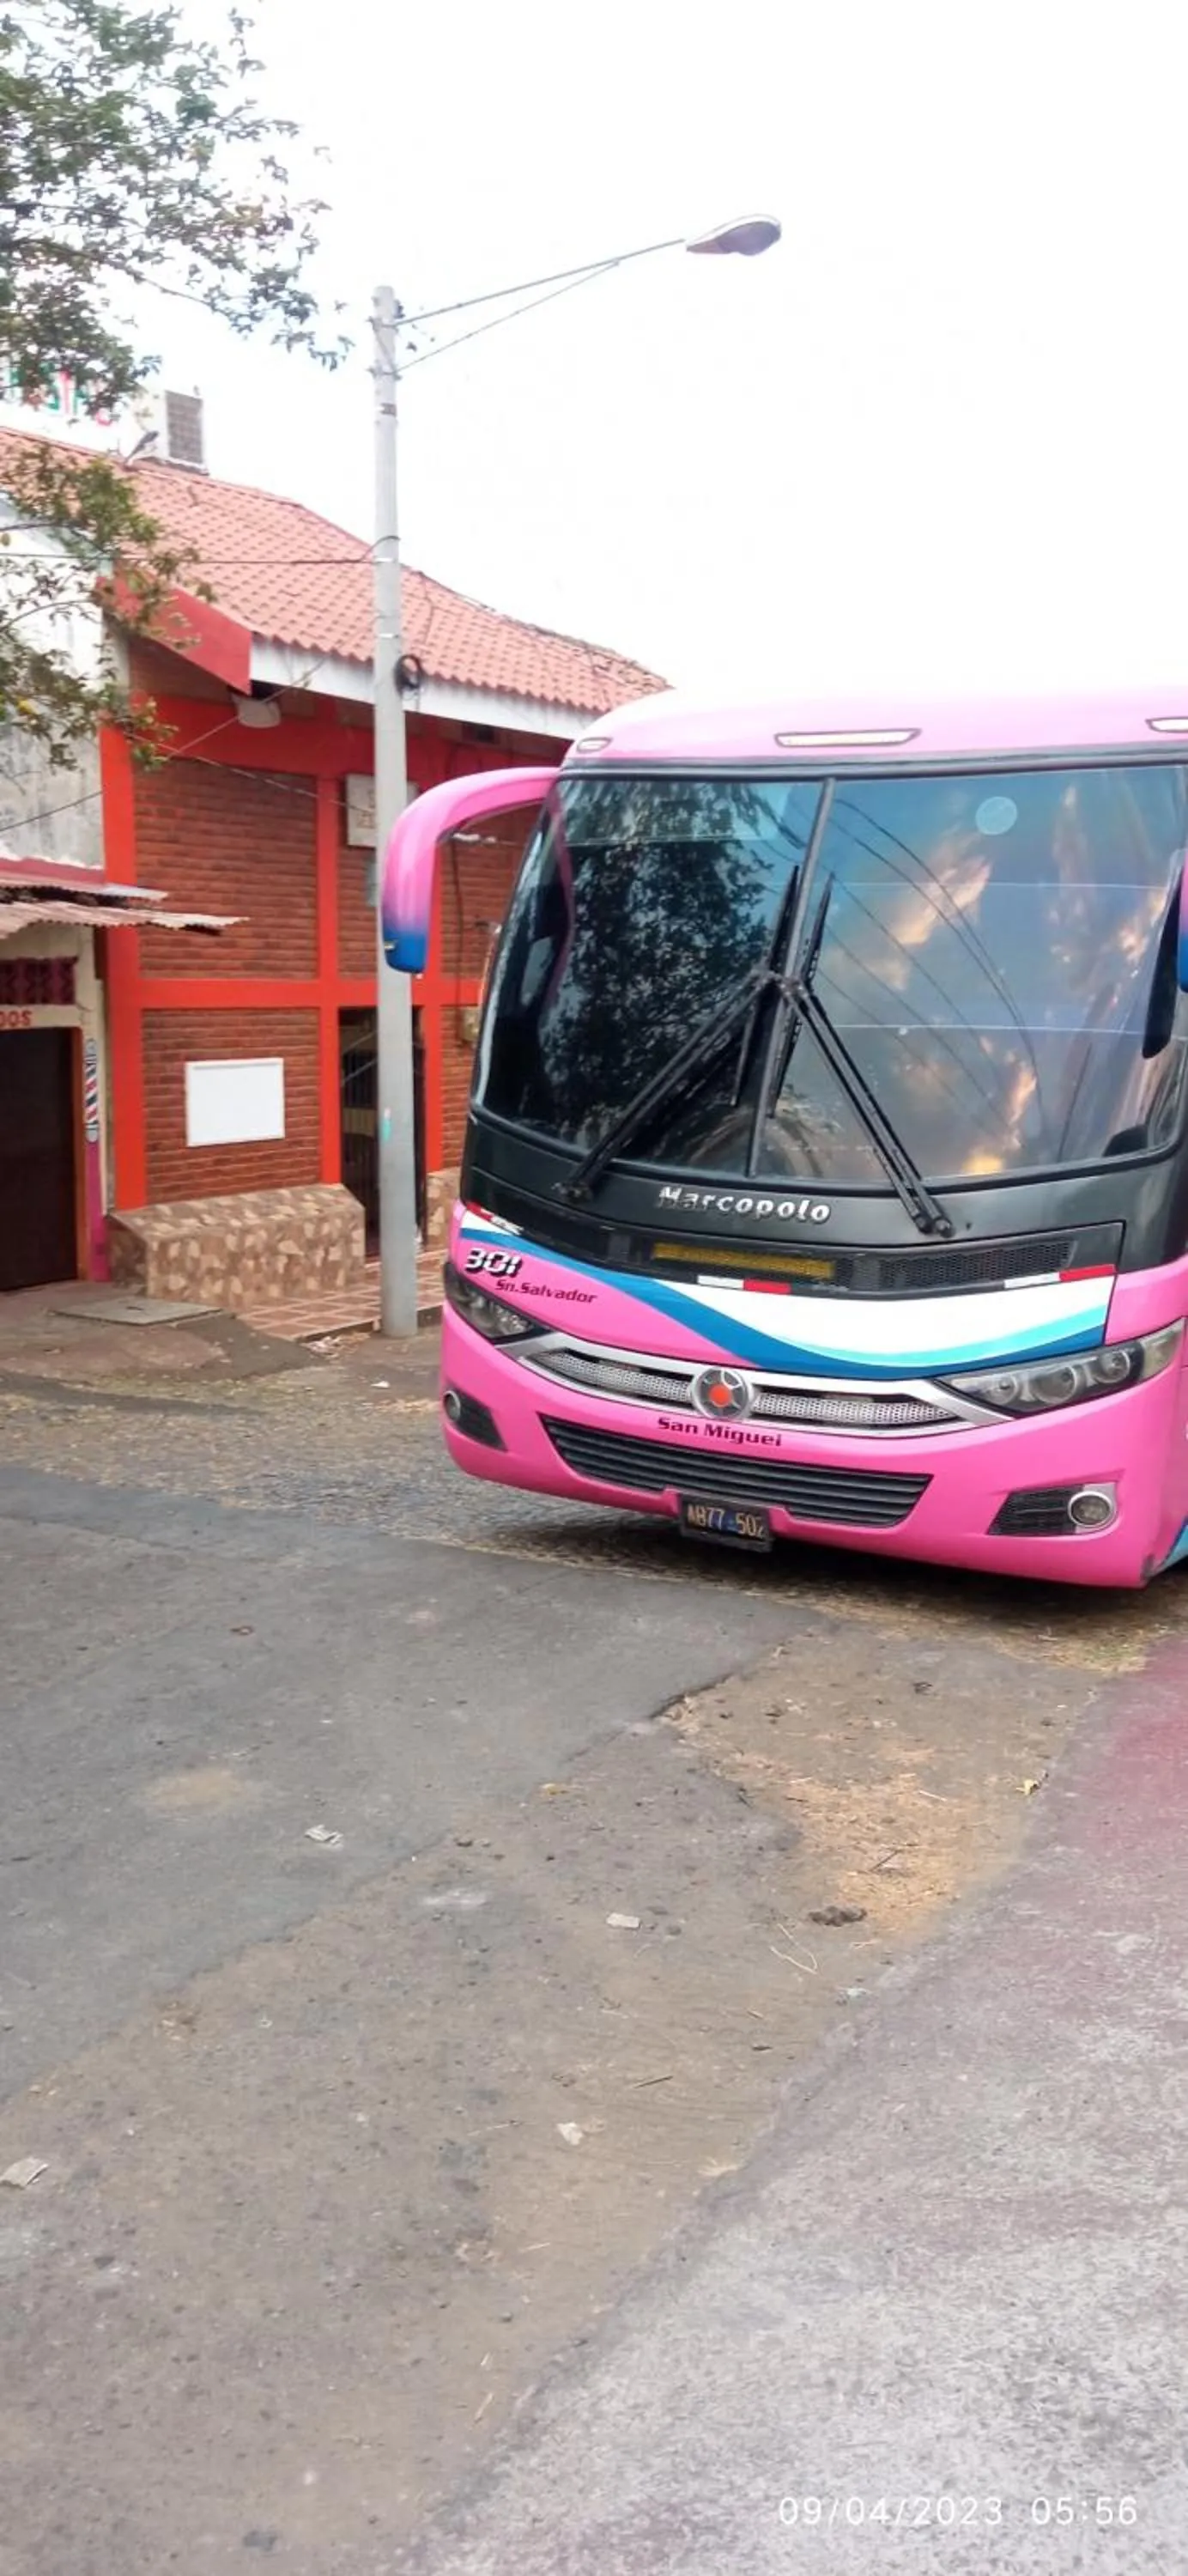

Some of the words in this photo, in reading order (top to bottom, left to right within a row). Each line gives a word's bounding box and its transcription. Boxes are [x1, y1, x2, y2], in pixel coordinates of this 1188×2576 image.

[658, 1186, 832, 1225] Marcopolo
[464, 1248, 523, 1278] 301
[658, 1417, 698, 1435] San
